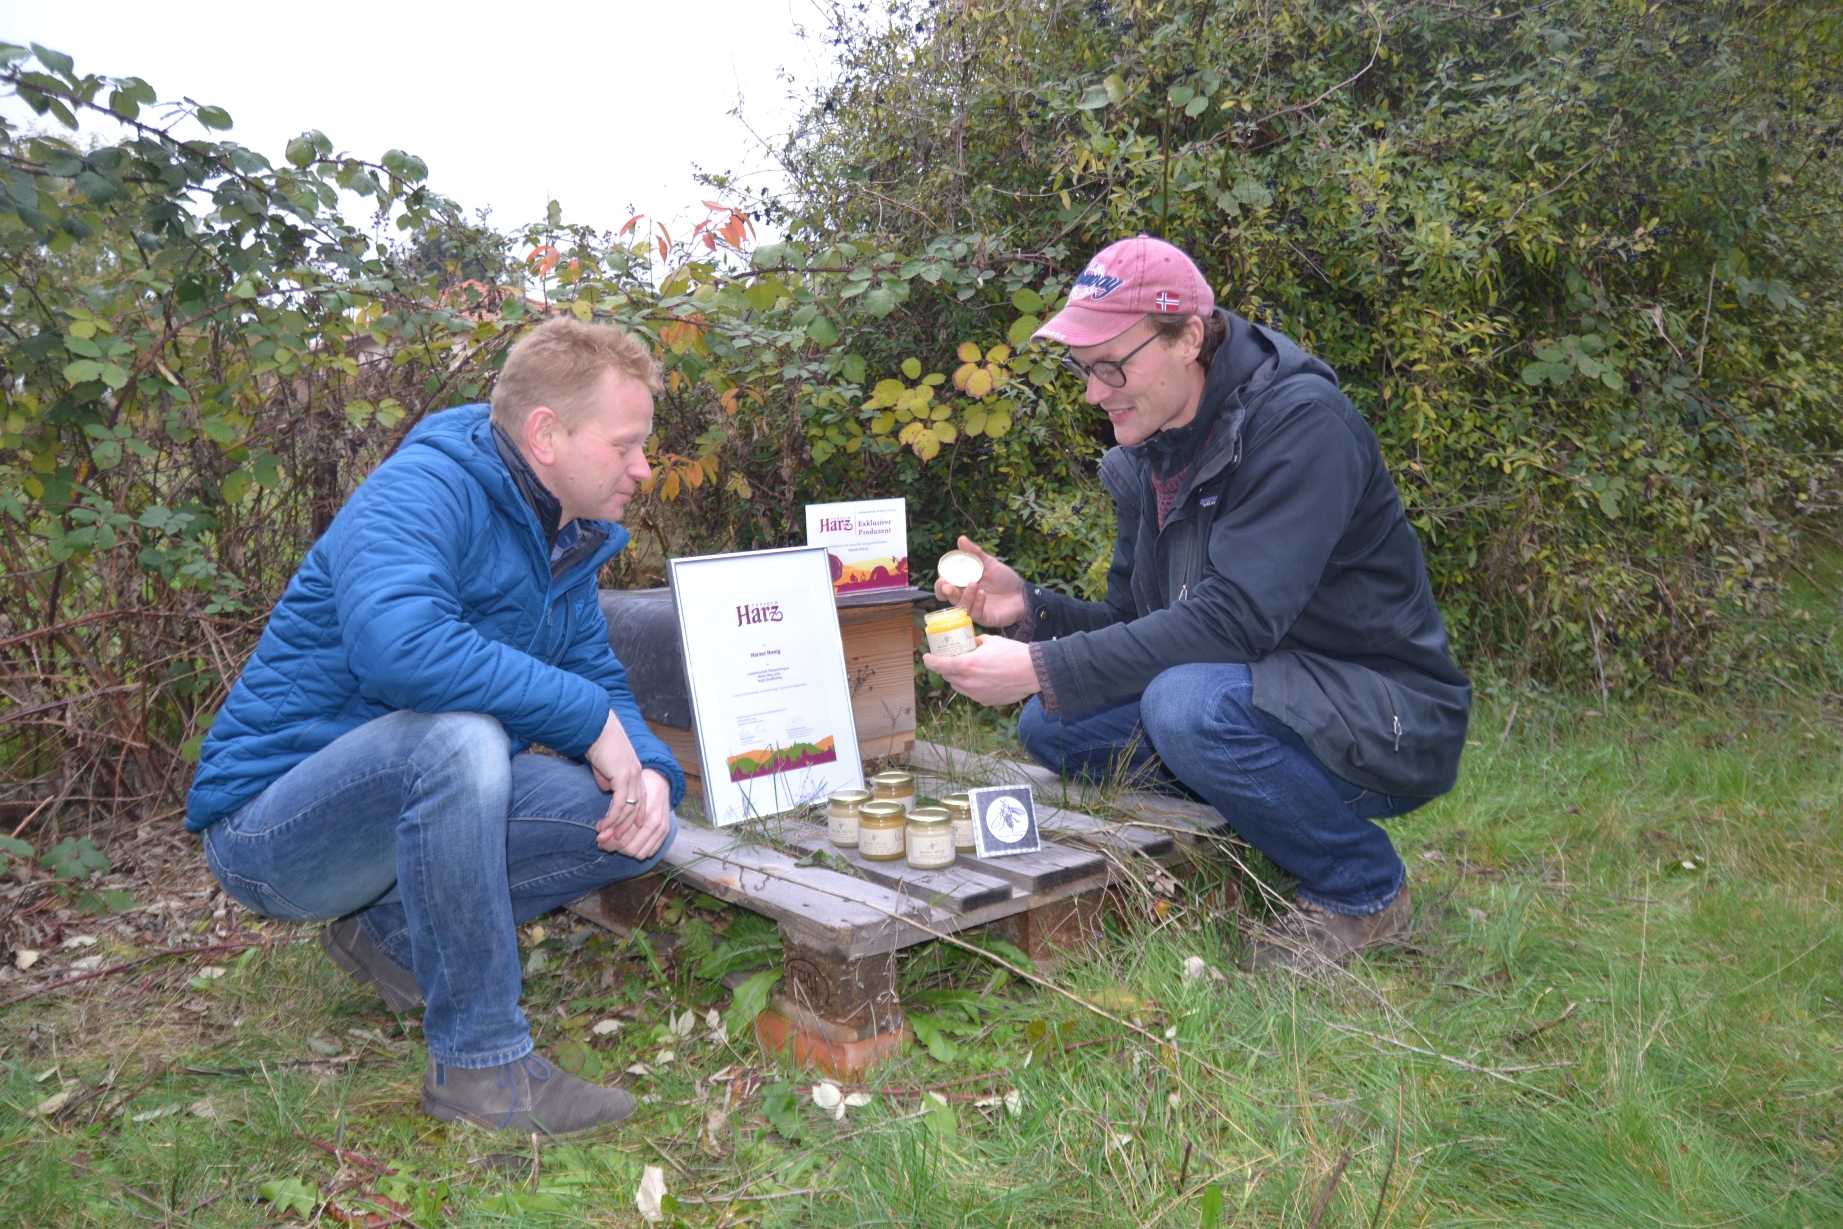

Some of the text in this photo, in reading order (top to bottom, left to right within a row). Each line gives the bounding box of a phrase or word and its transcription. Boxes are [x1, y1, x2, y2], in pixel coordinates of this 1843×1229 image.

[820, 517, 853, 534] Harz
[858, 519, 892, 528] Exklusiver
[858, 528, 892, 536] Produzent
[735, 604, 784, 628] Harz
[766, 648, 781, 656] Honig
